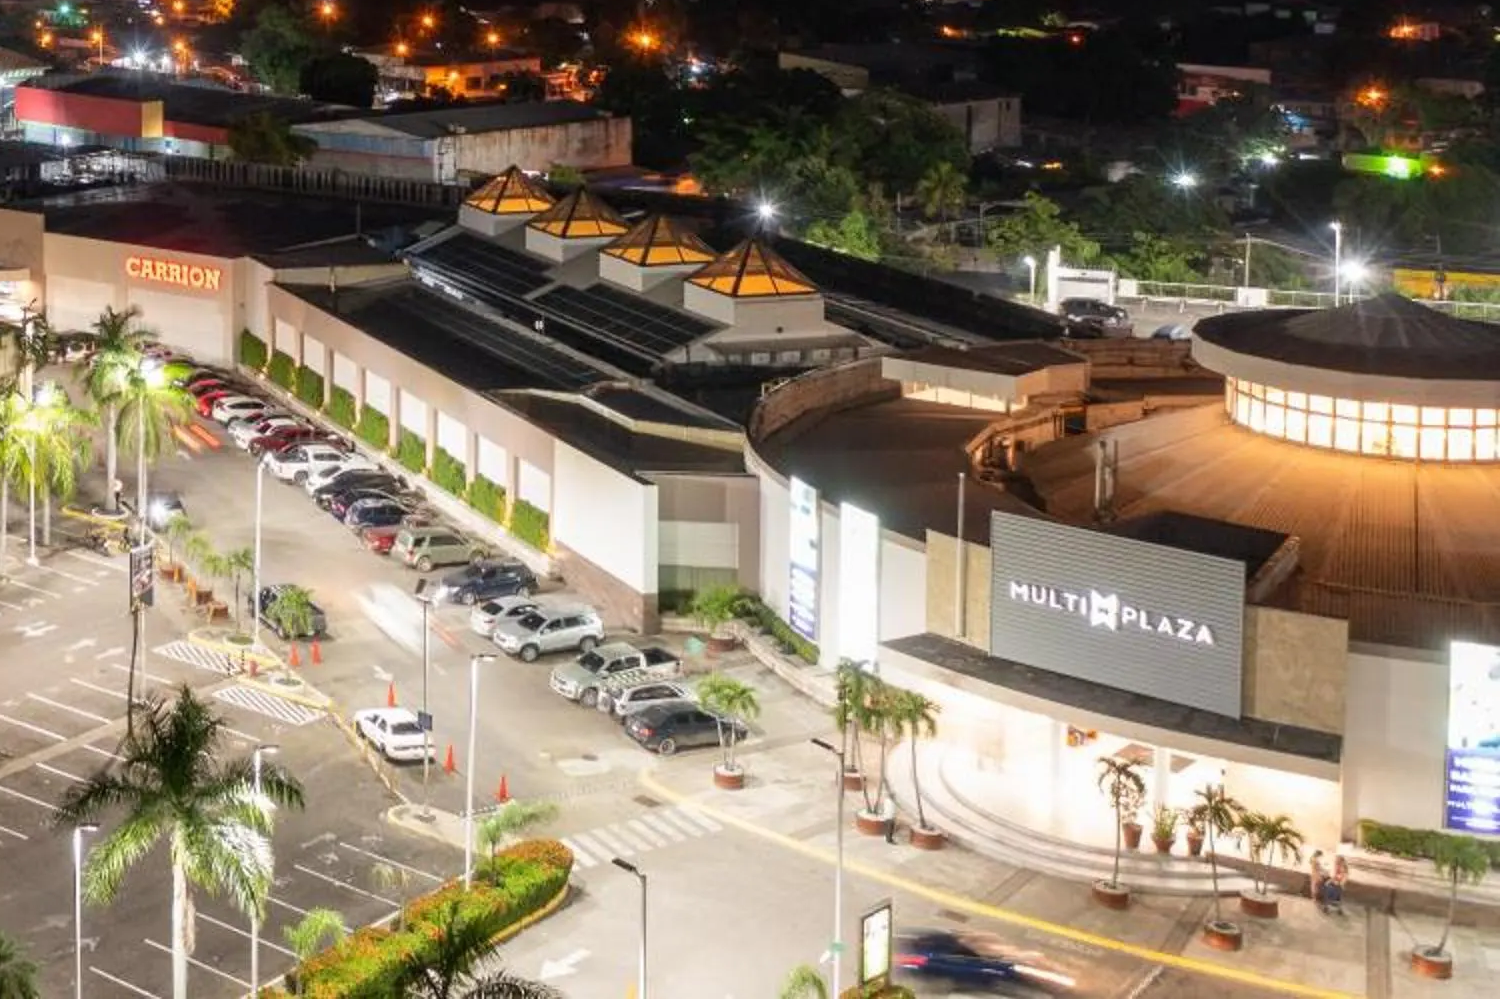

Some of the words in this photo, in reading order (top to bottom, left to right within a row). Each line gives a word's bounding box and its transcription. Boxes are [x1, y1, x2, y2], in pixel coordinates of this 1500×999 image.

[125, 257, 221, 290] CARRION
[1010, 581, 1087, 616] MULTI
[1121, 606, 1214, 645] PLAZA
